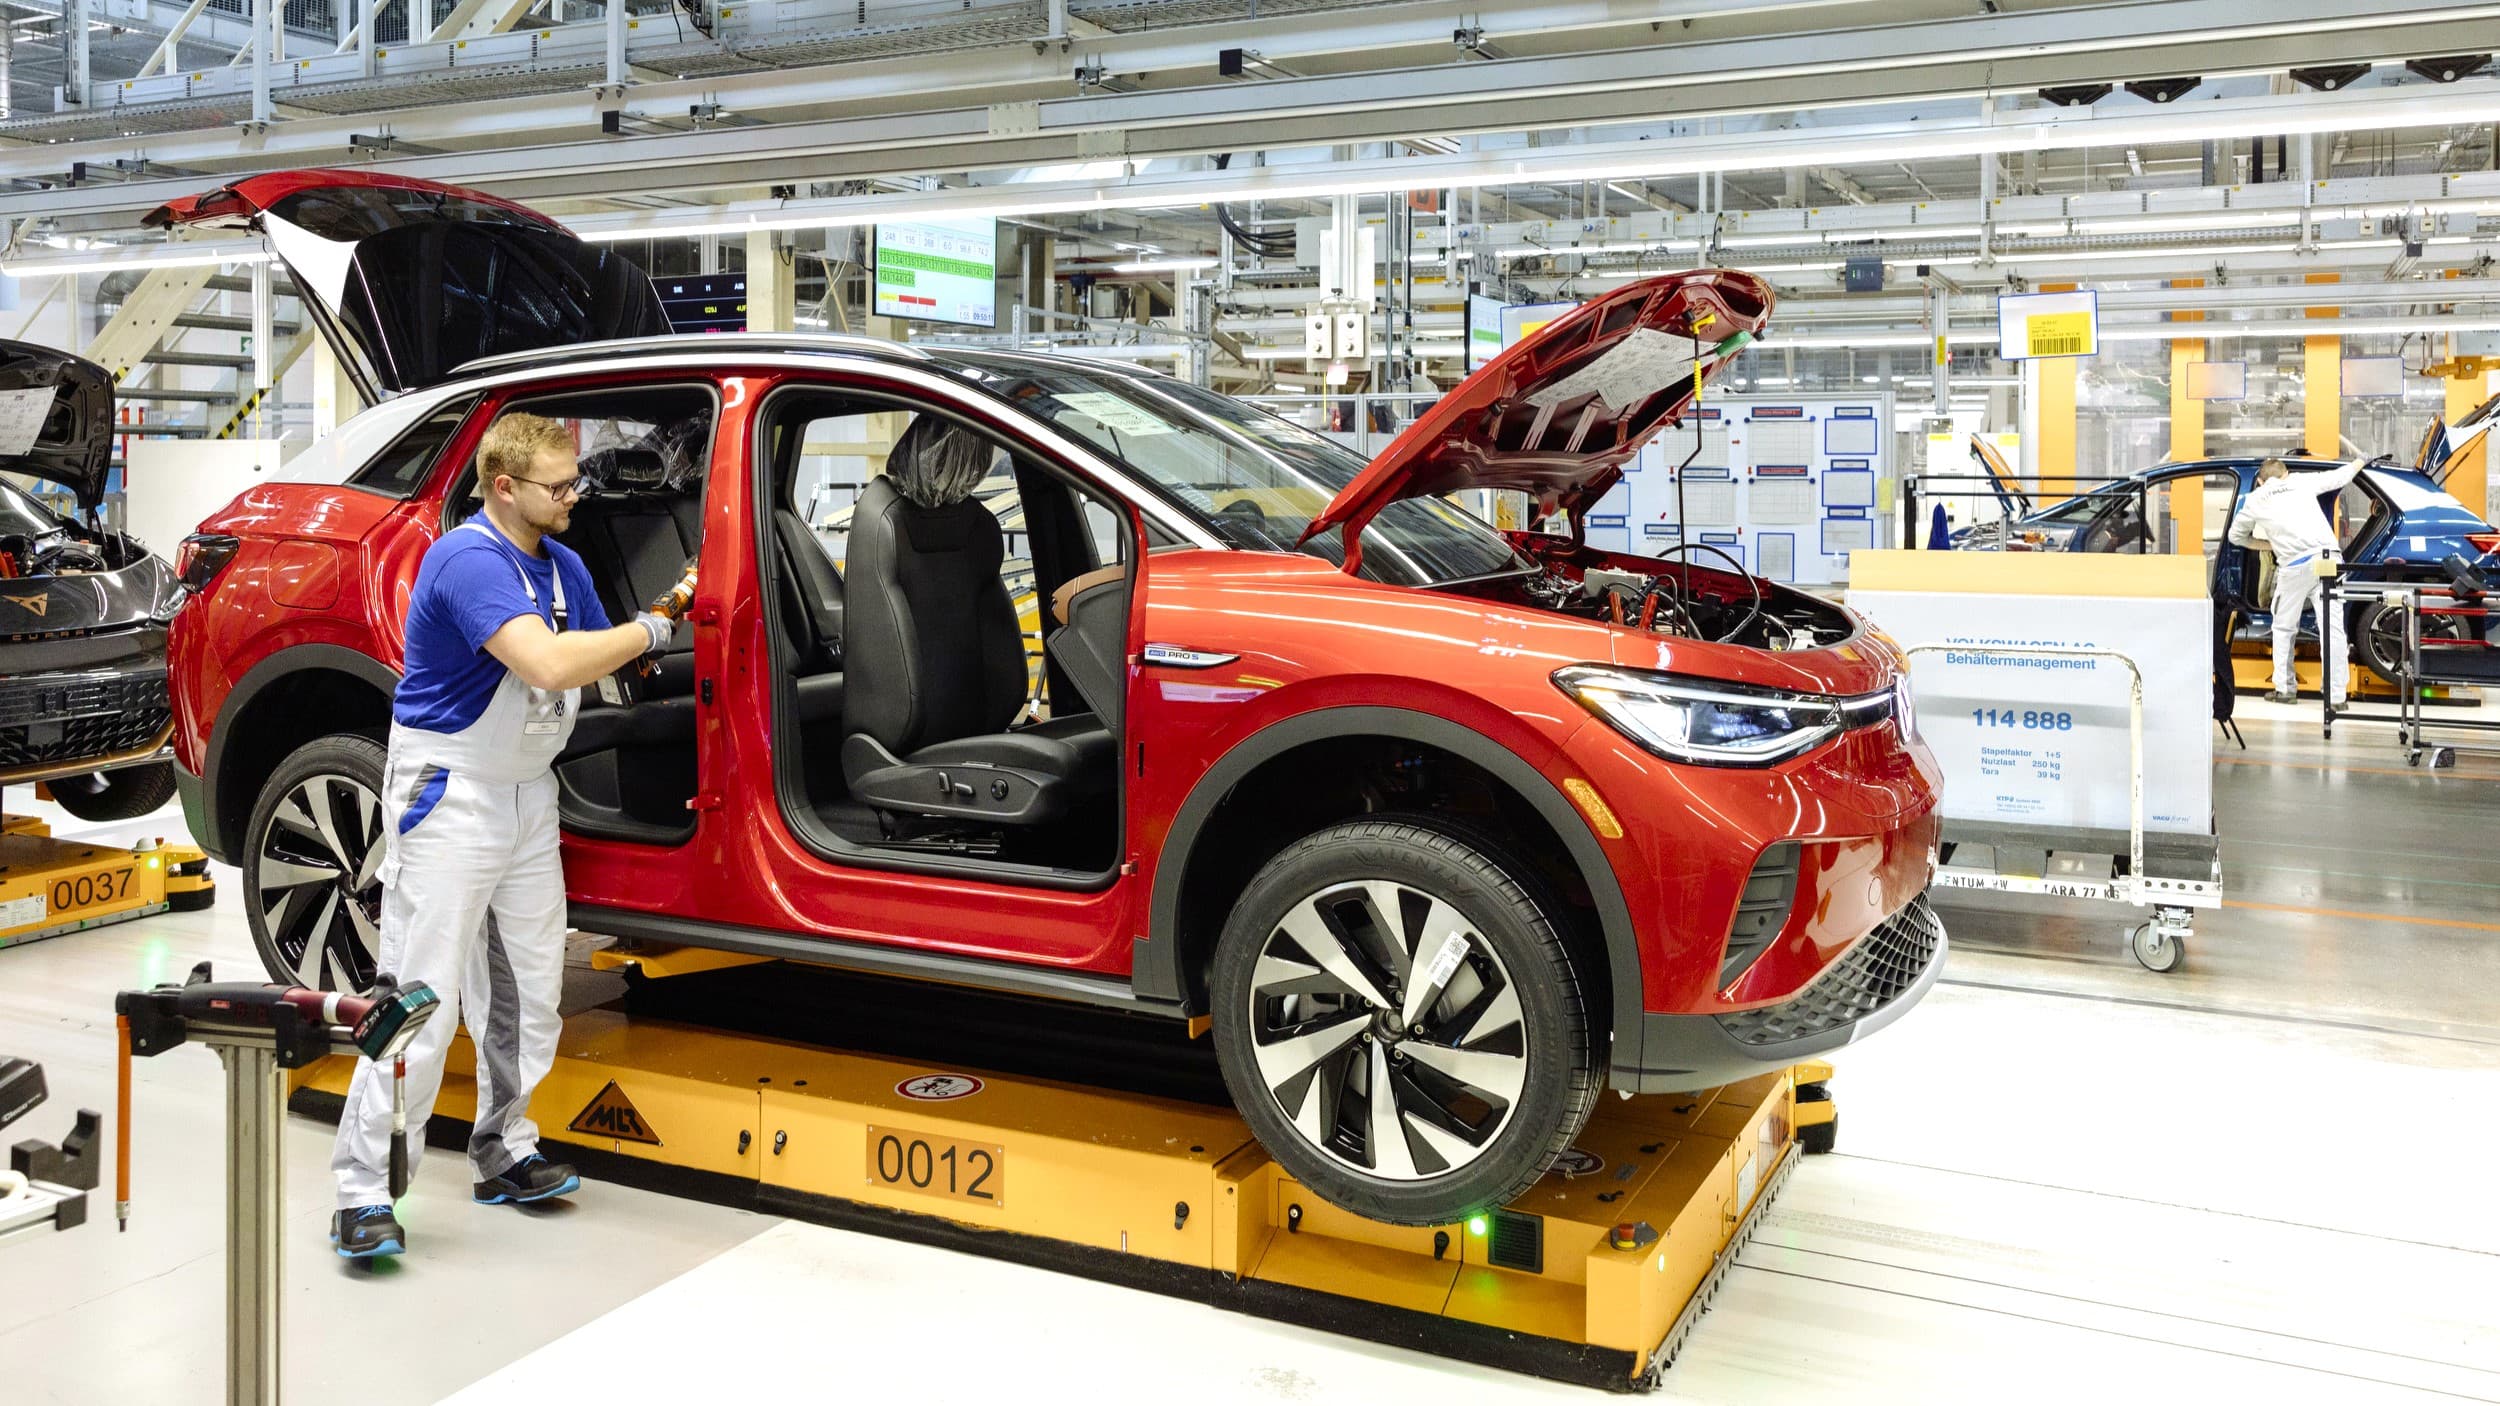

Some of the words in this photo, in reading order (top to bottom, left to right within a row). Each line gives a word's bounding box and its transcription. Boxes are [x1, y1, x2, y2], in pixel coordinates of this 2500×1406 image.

[12, 629, 84, 641] CUPRA
[1168, 651, 1190, 660] PRO
[1946, 653, 2096, 670] Behältermanagement
[1972, 708, 2016, 728] 114
[2023, 710, 2073, 731] 888
[1981, 747, 2033, 757] Stapelfaktor
[1981, 757, 2016, 766] Nutzlast
[2050, 761, 2061, 771] kg
[1981, 767, 1999, 776] Tara
[2050, 771, 2061, 781] kg
[53, 867, 134, 911] 0037
[2083, 887, 2097, 898] 77
[585, 1104, 644, 1136] MLR
[878, 1135, 994, 1199] 0012
